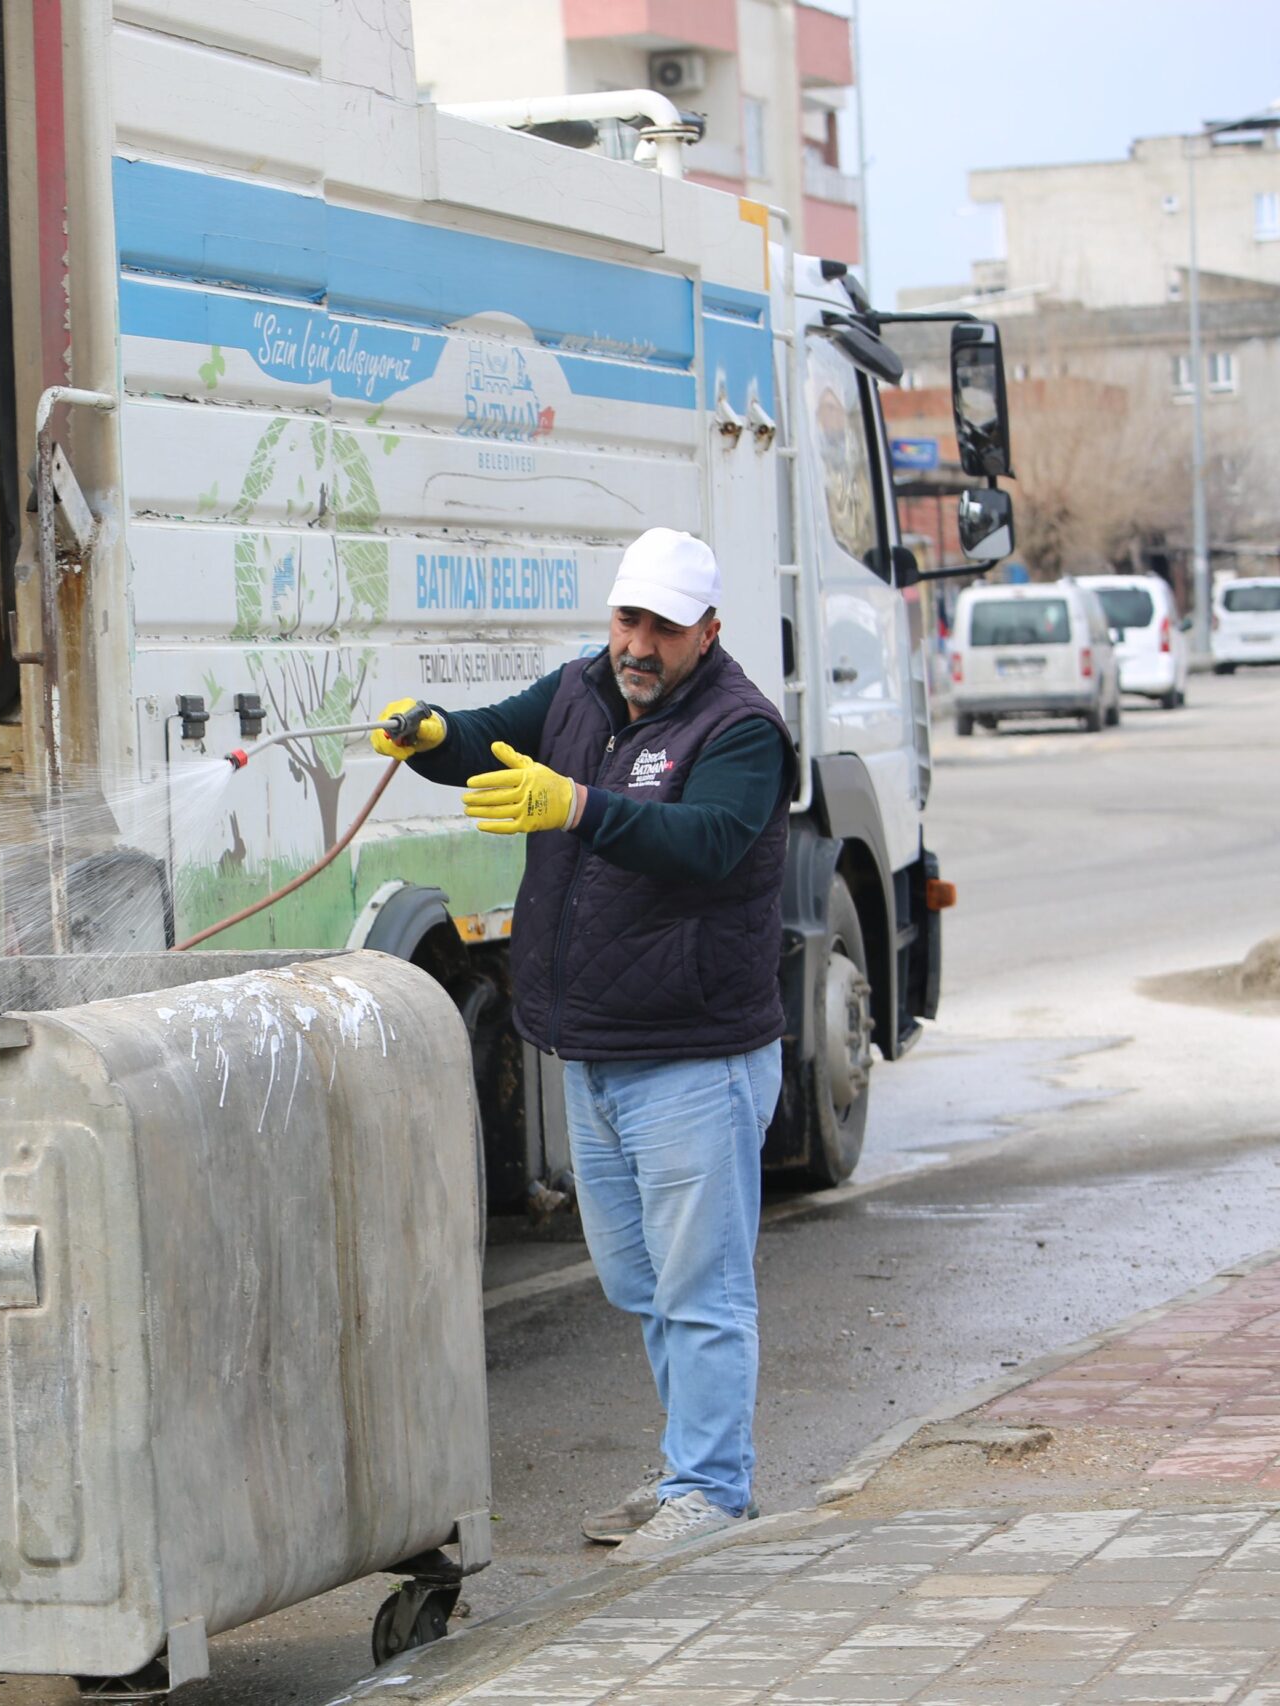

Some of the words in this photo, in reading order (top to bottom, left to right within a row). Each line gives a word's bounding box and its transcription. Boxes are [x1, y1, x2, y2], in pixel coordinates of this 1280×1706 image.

[457, 393, 541, 441] BATMAN
[416, 553, 487, 610] BATMAN
[491, 548, 579, 610] BELEDİYESİ
